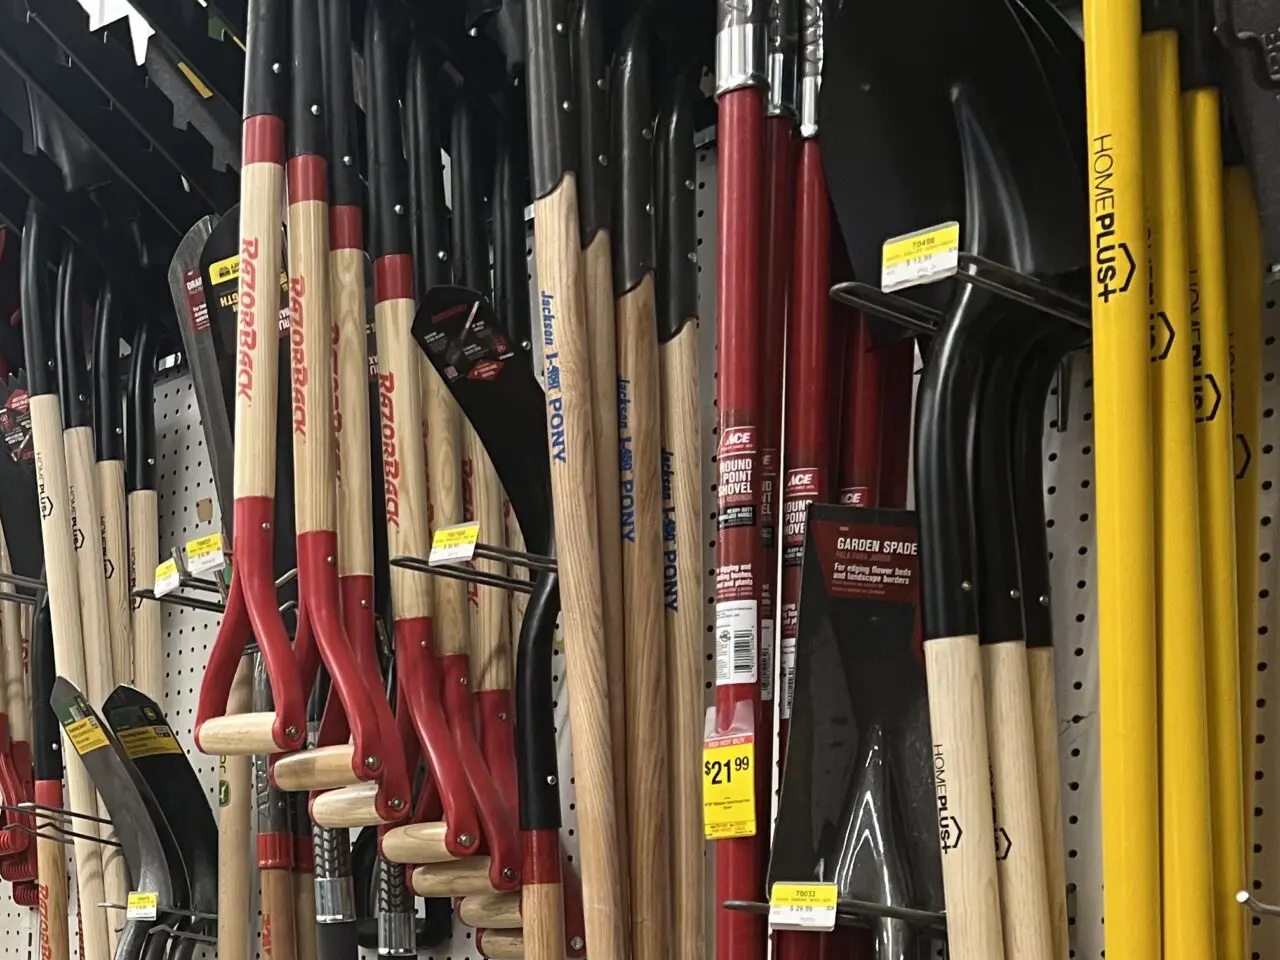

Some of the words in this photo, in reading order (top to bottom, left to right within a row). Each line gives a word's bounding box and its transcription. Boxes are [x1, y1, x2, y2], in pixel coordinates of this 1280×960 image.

[542, 290, 554, 345] Jackson
[549, 398, 566, 464] PONY
[618, 377, 631, 430] Jackson
[726, 433, 751, 445] ACE
[661, 447, 674, 501] Jackson
[620, 480, 636, 543] PONY
[834, 562, 845, 571] For
[847, 564, 870, 574] edging
[872, 565, 893, 574] flower
[895, 568, 912, 576] beds
[837, 537, 880, 552] GARDEN
[883, 541, 918, 555] SPADE
[664, 550, 679, 613] PONY
[833, 571, 845, 579] and
[847, 573, 881, 583] landscape
[883, 575, 909, 584] borders
[933, 744, 951, 854] HOMEPLUS+
